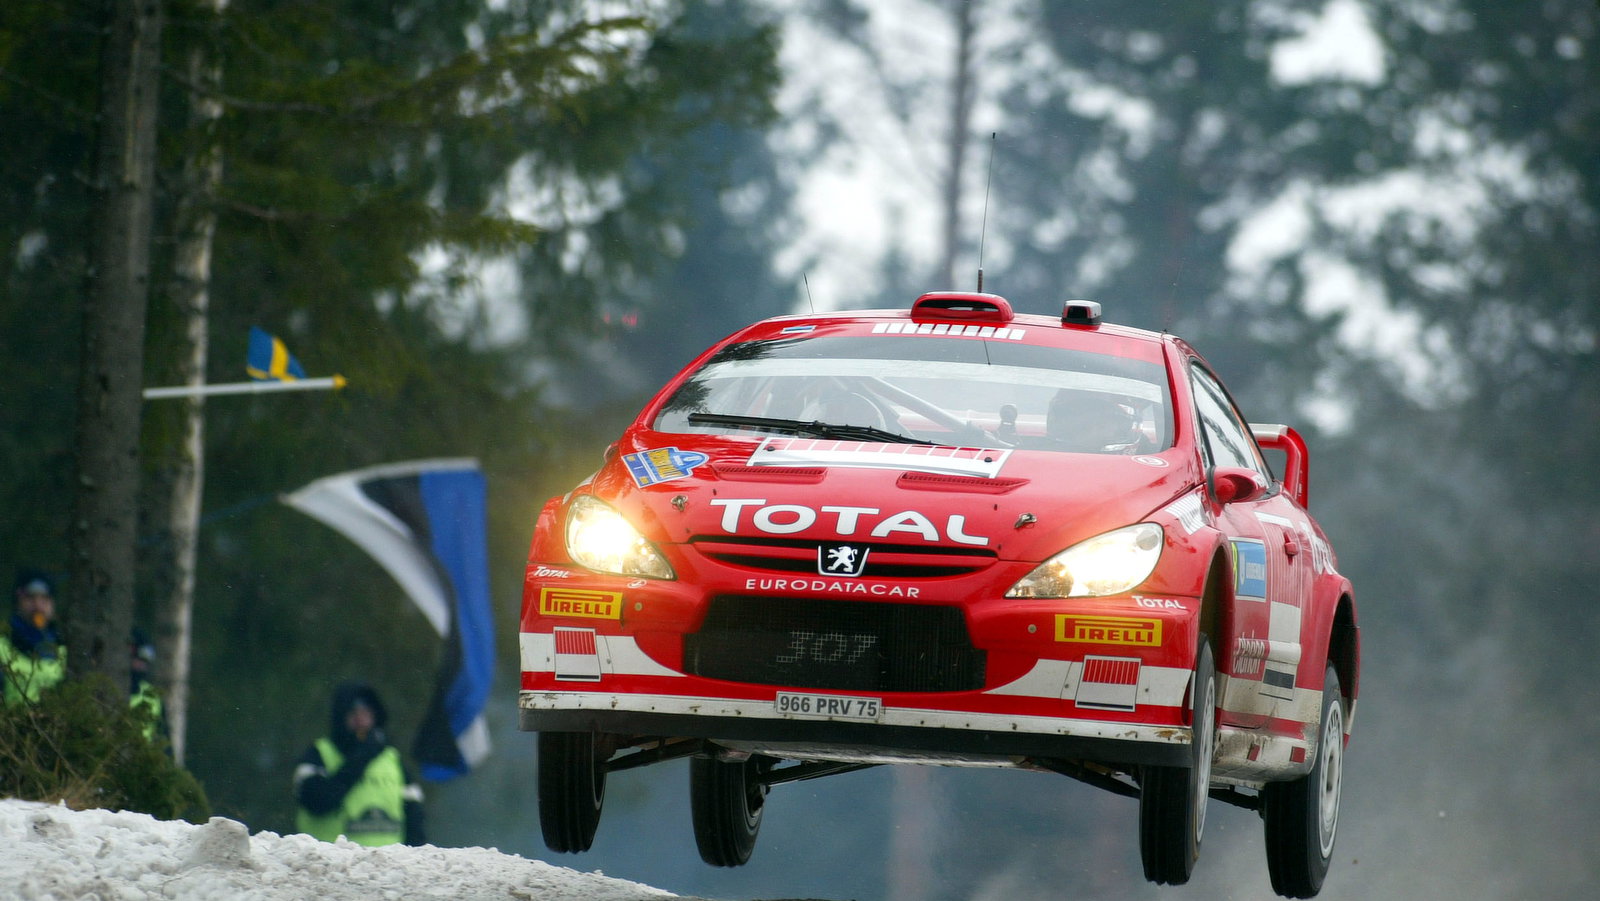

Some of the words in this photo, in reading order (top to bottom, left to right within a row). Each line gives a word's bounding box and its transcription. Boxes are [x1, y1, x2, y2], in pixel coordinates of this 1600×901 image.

[709, 498, 989, 546] TOTAL
[533, 565, 570, 578] TOTAL
[745, 578, 920, 598] EURODATACAR
[545, 591, 614, 616] PIRELLI
[1131, 595, 1187, 609] TOTAL
[1064, 618, 1154, 643] PIRELLI
[780, 695, 811, 713] 966
[816, 698, 852, 715] PRV
[857, 701, 877, 719] 75
